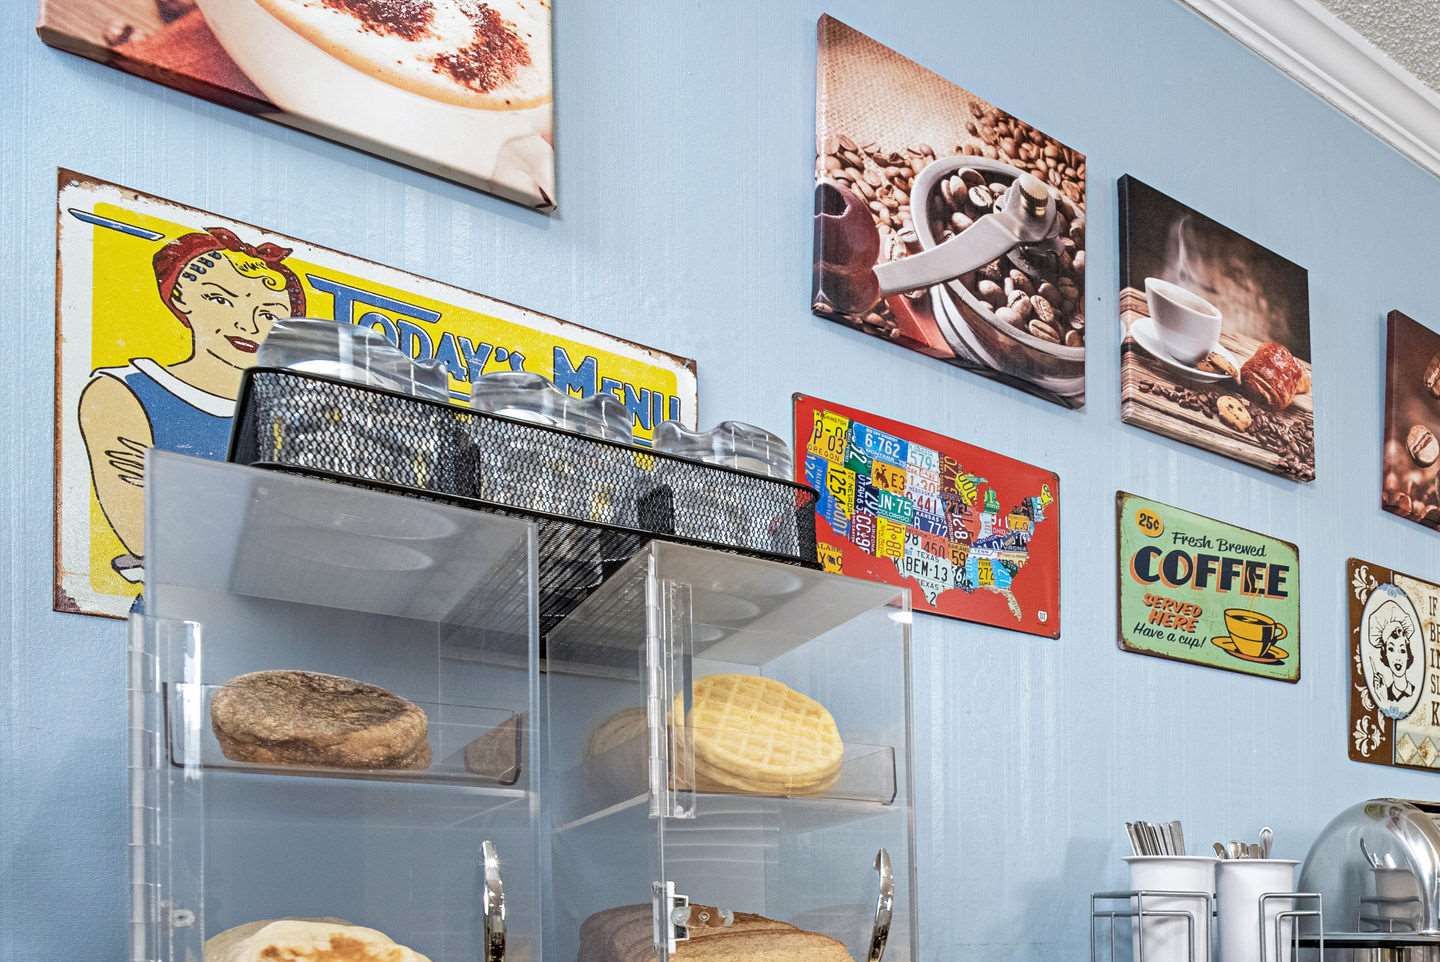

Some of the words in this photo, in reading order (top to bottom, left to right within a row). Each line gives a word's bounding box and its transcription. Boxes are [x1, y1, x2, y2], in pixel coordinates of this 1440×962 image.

[553, 346, 681, 430] MENU
[1138, 512, 1160, 531] 25¢
[1171, 531, 1214, 550] Fresh
[1216, 538, 1267, 558] Brewed
[1130, 545, 1290, 600] COFFEE
[1143, 592, 1202, 618] SERVED
[1428, 595, 1438, 617] IF
[1148, 609, 1200, 634] HERE
[1133, 622, 1164, 640] Have
[1167, 632, 1176, 642] a
[1178, 635, 1207, 649] cup!
